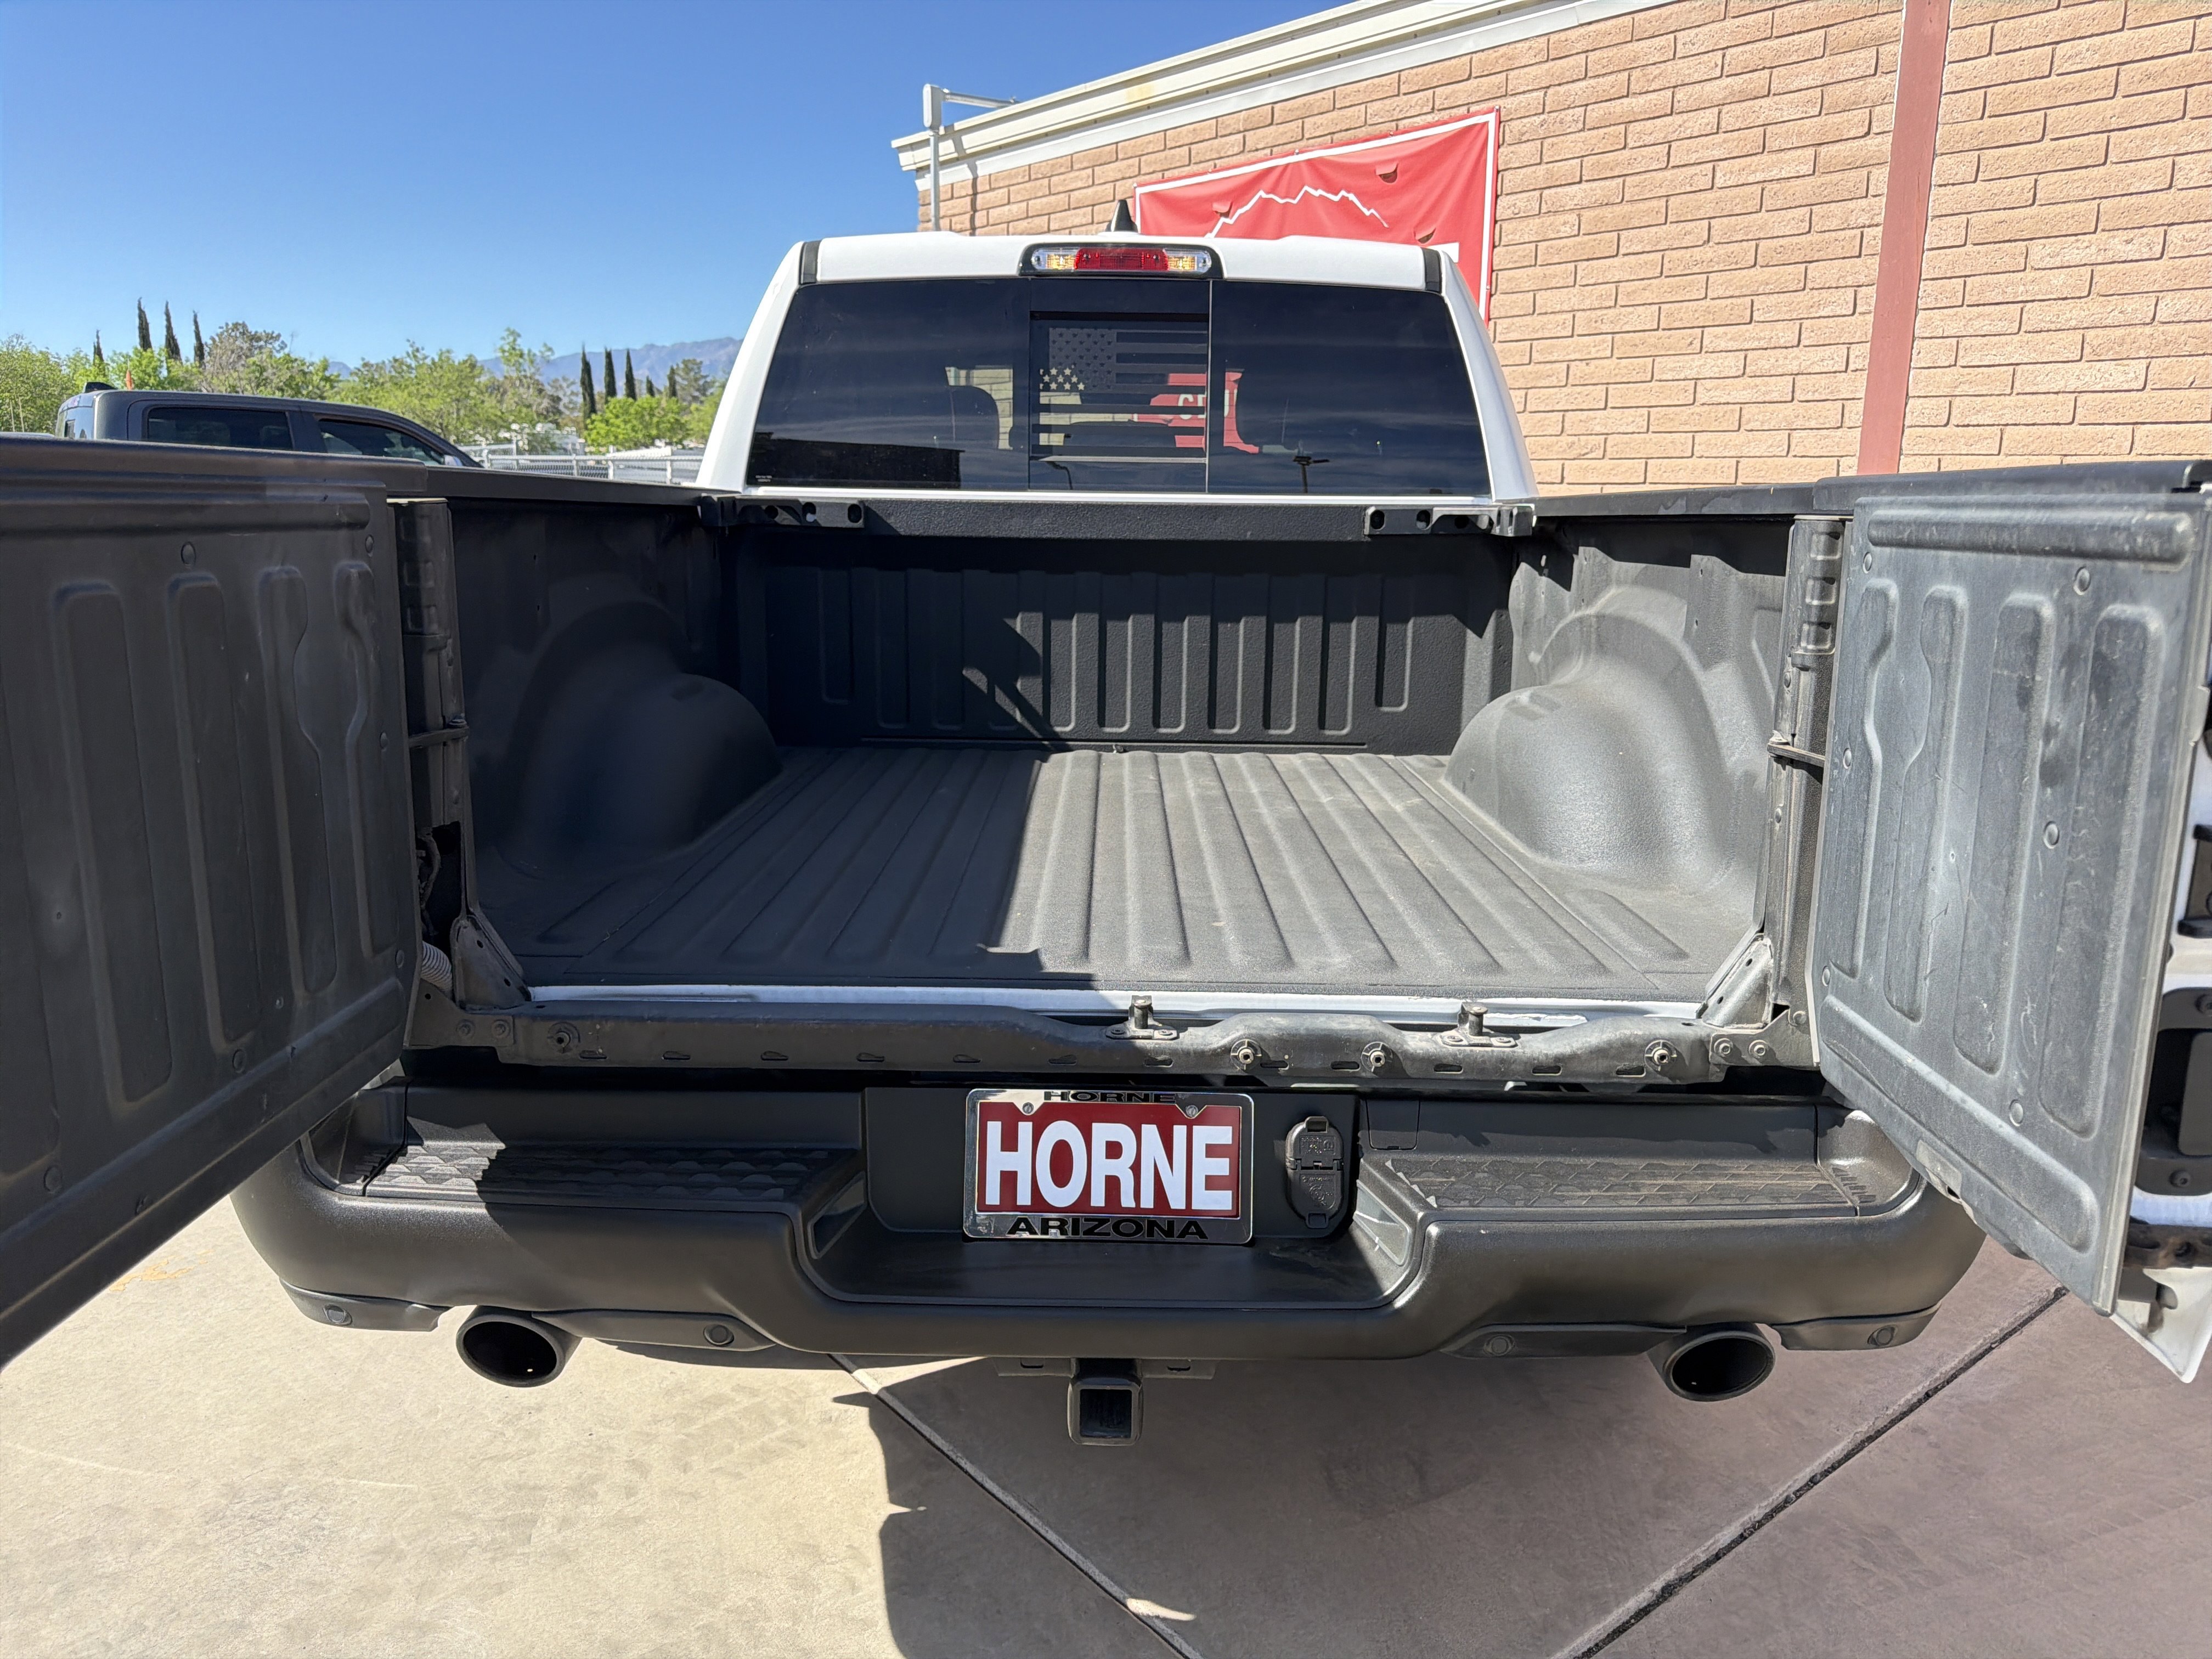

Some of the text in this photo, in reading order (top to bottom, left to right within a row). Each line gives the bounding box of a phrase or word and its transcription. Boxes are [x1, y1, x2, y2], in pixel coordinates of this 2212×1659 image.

[1043, 1091, 1176, 1104] HORNE
[985, 1120, 1233, 1210] HORNE
[1006, 1216, 1208, 1239] ARIZONA
